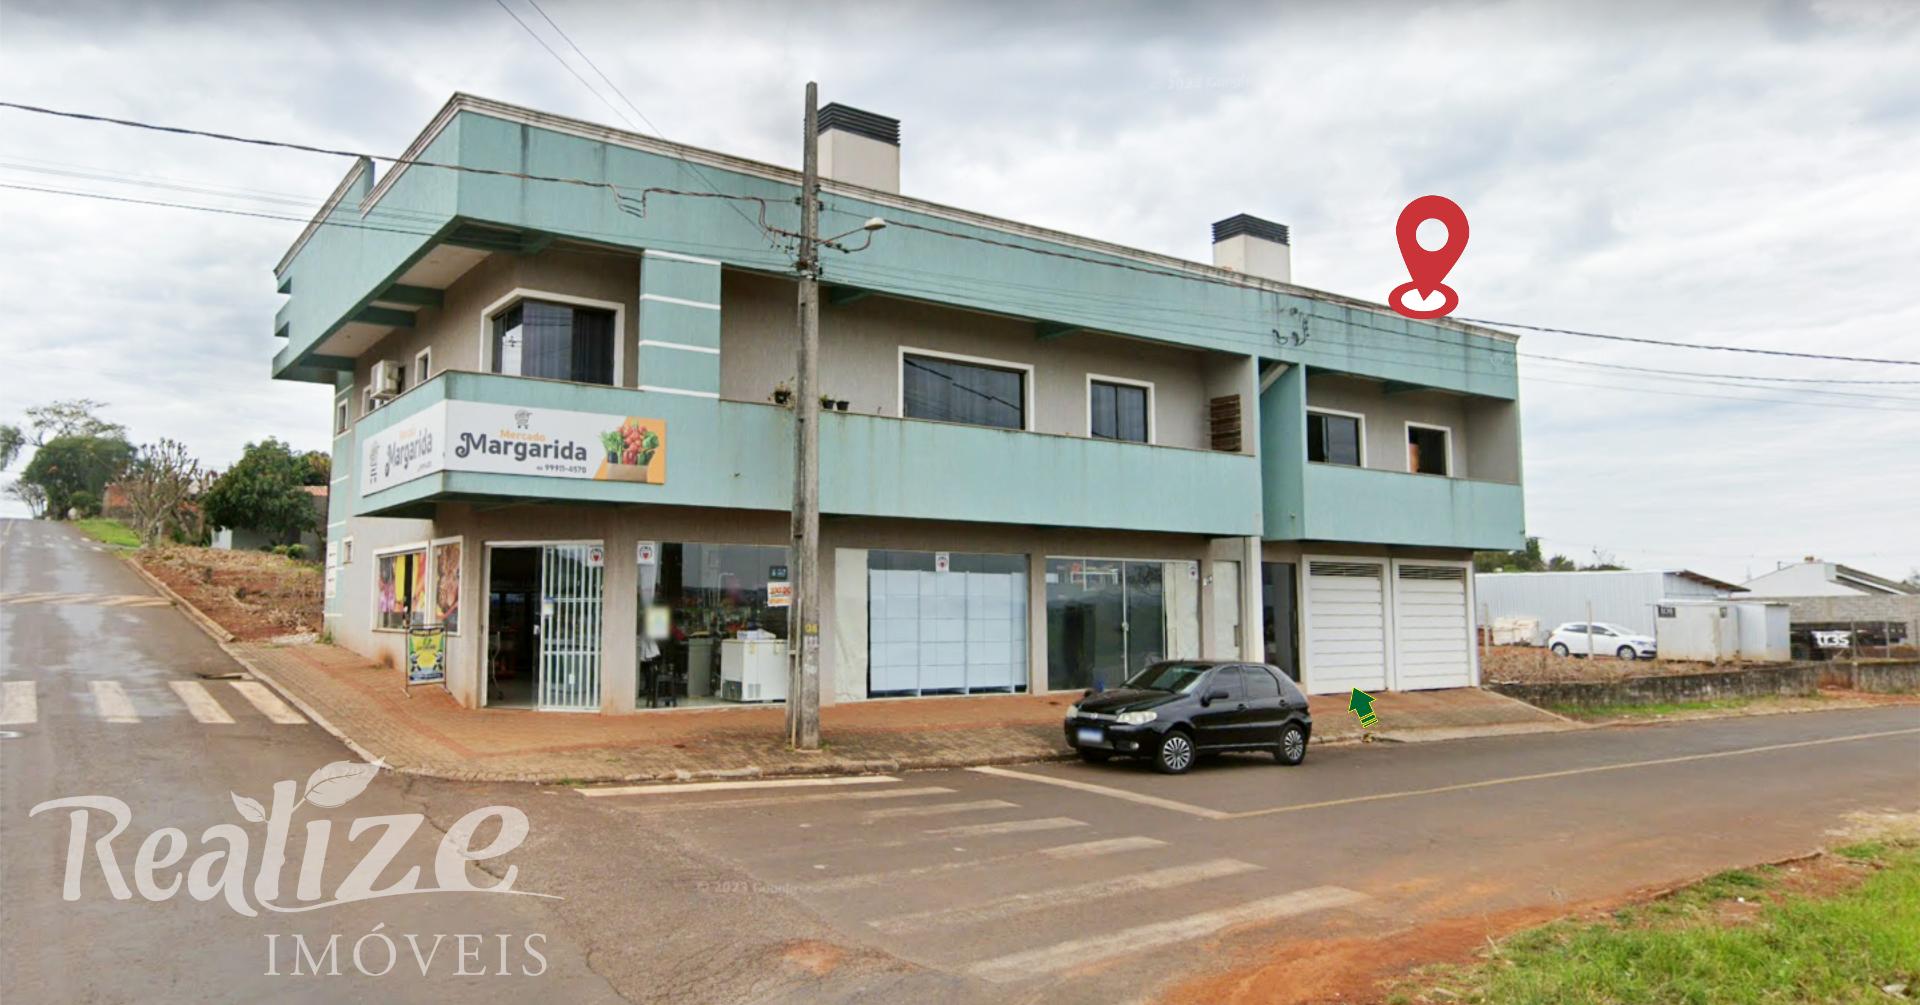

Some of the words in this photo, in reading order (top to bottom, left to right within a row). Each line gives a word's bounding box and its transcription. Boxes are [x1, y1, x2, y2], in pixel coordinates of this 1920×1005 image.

[455, 431, 587, 462] Margarida
[500, 430, 546, 442] Mercado
[384, 427, 433, 477] Margarida
